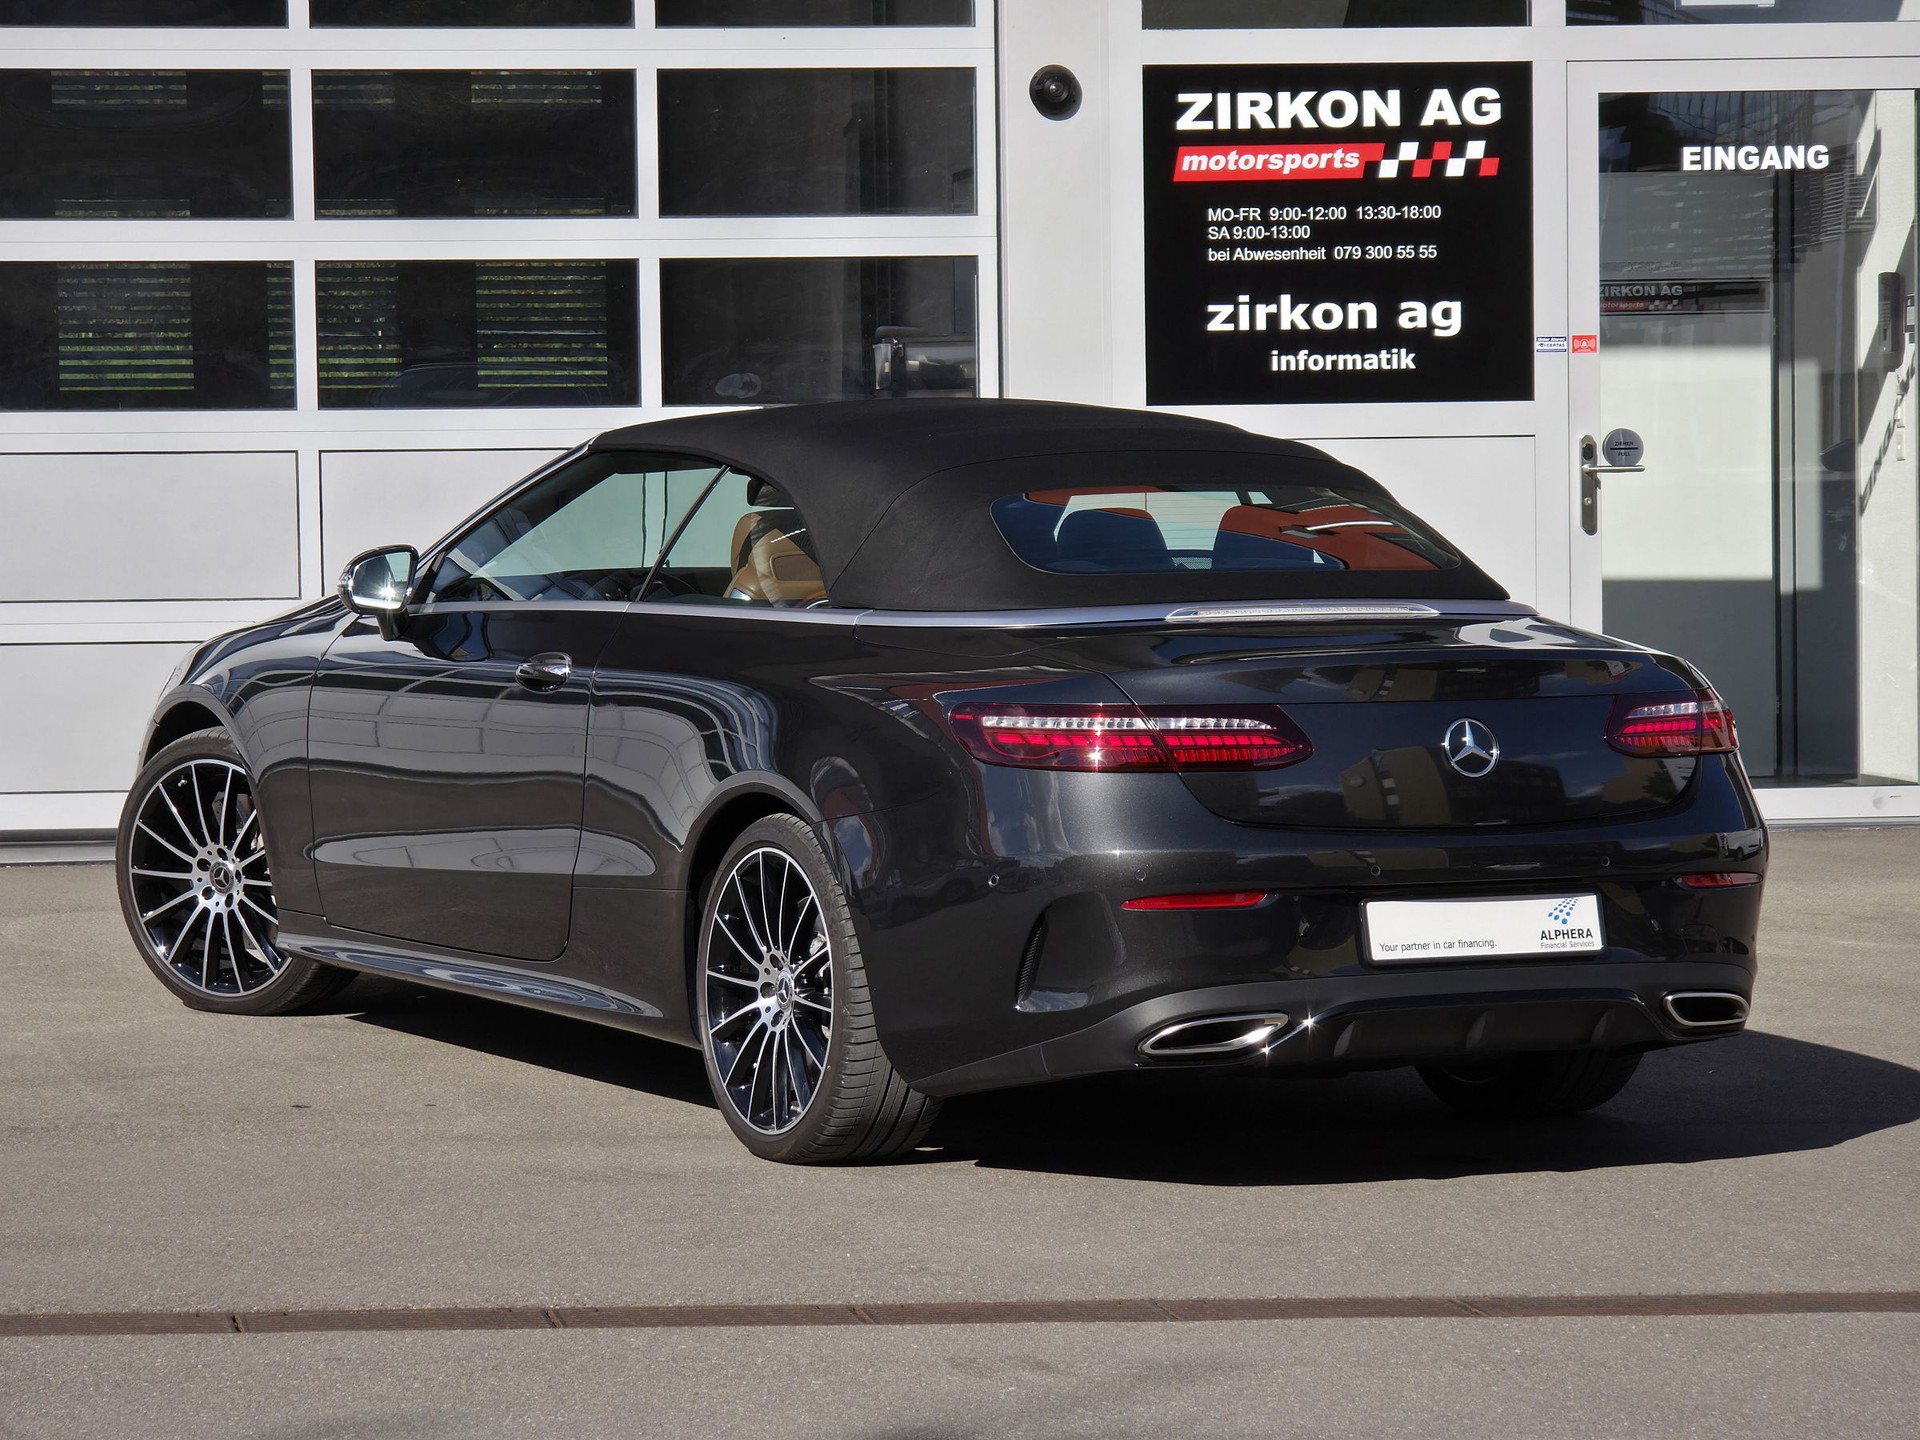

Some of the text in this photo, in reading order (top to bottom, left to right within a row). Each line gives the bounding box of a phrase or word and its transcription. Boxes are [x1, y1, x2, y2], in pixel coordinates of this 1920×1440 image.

[1176, 88, 1501, 130] ZIRKON AG
[1182, 148, 1360, 174] motorsports
[1682, 145, 1829, 171] EINGANG
[1208, 205, 1441, 221] MO-FR 9:00-12:00 13:30-18:00
[1208, 226, 1310, 239] SA 9:00-13:00
[1209, 245, 1437, 261] bei Abwesenheit 079 300 55 55
[1661, 285, 1683, 296] AG
[1207, 294, 1461, 336] zirkon ag
[1272, 348, 1416, 371] informatik
[1541, 928, 1593, 940] ALPHERA
[1380, 944, 1398, 952] Your
[1401, 943, 1430, 953] partner
[1433, 941, 1440, 949] in
[1458, 939, 1497, 949] financing.
